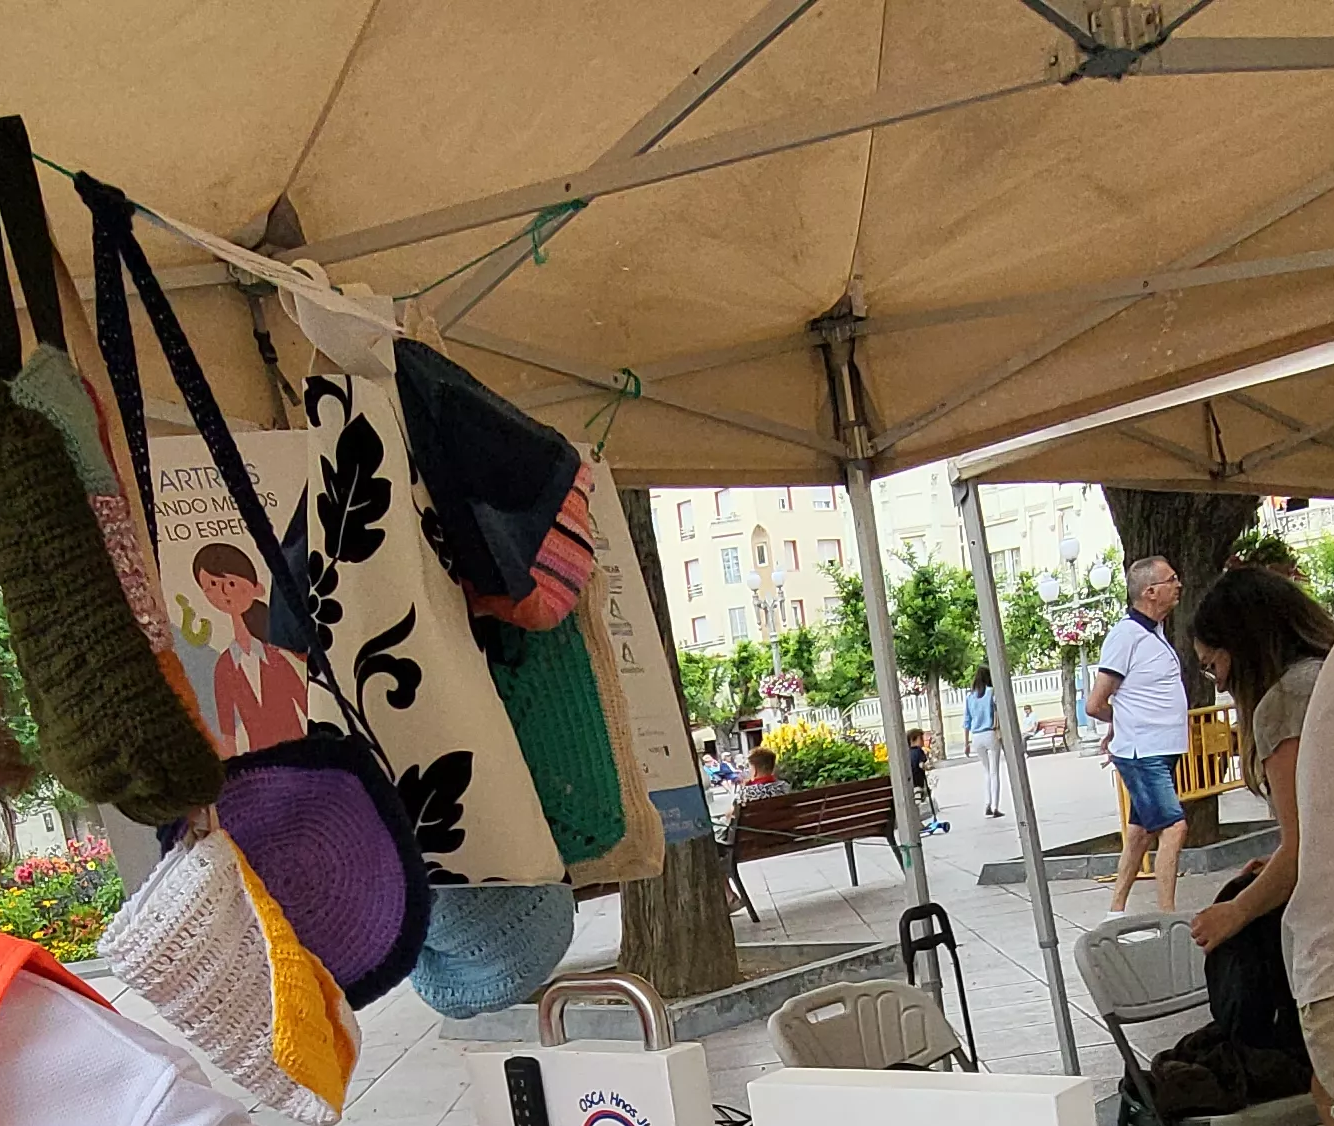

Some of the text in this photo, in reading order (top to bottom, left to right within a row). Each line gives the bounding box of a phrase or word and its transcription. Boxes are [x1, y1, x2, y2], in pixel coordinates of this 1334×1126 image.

[160, 463, 260, 494] ARTRS
[165, 524, 191, 542] LO
[579, 1090, 606, 1112] OSCA
[610, 1091, 638, 1118] Hnos
